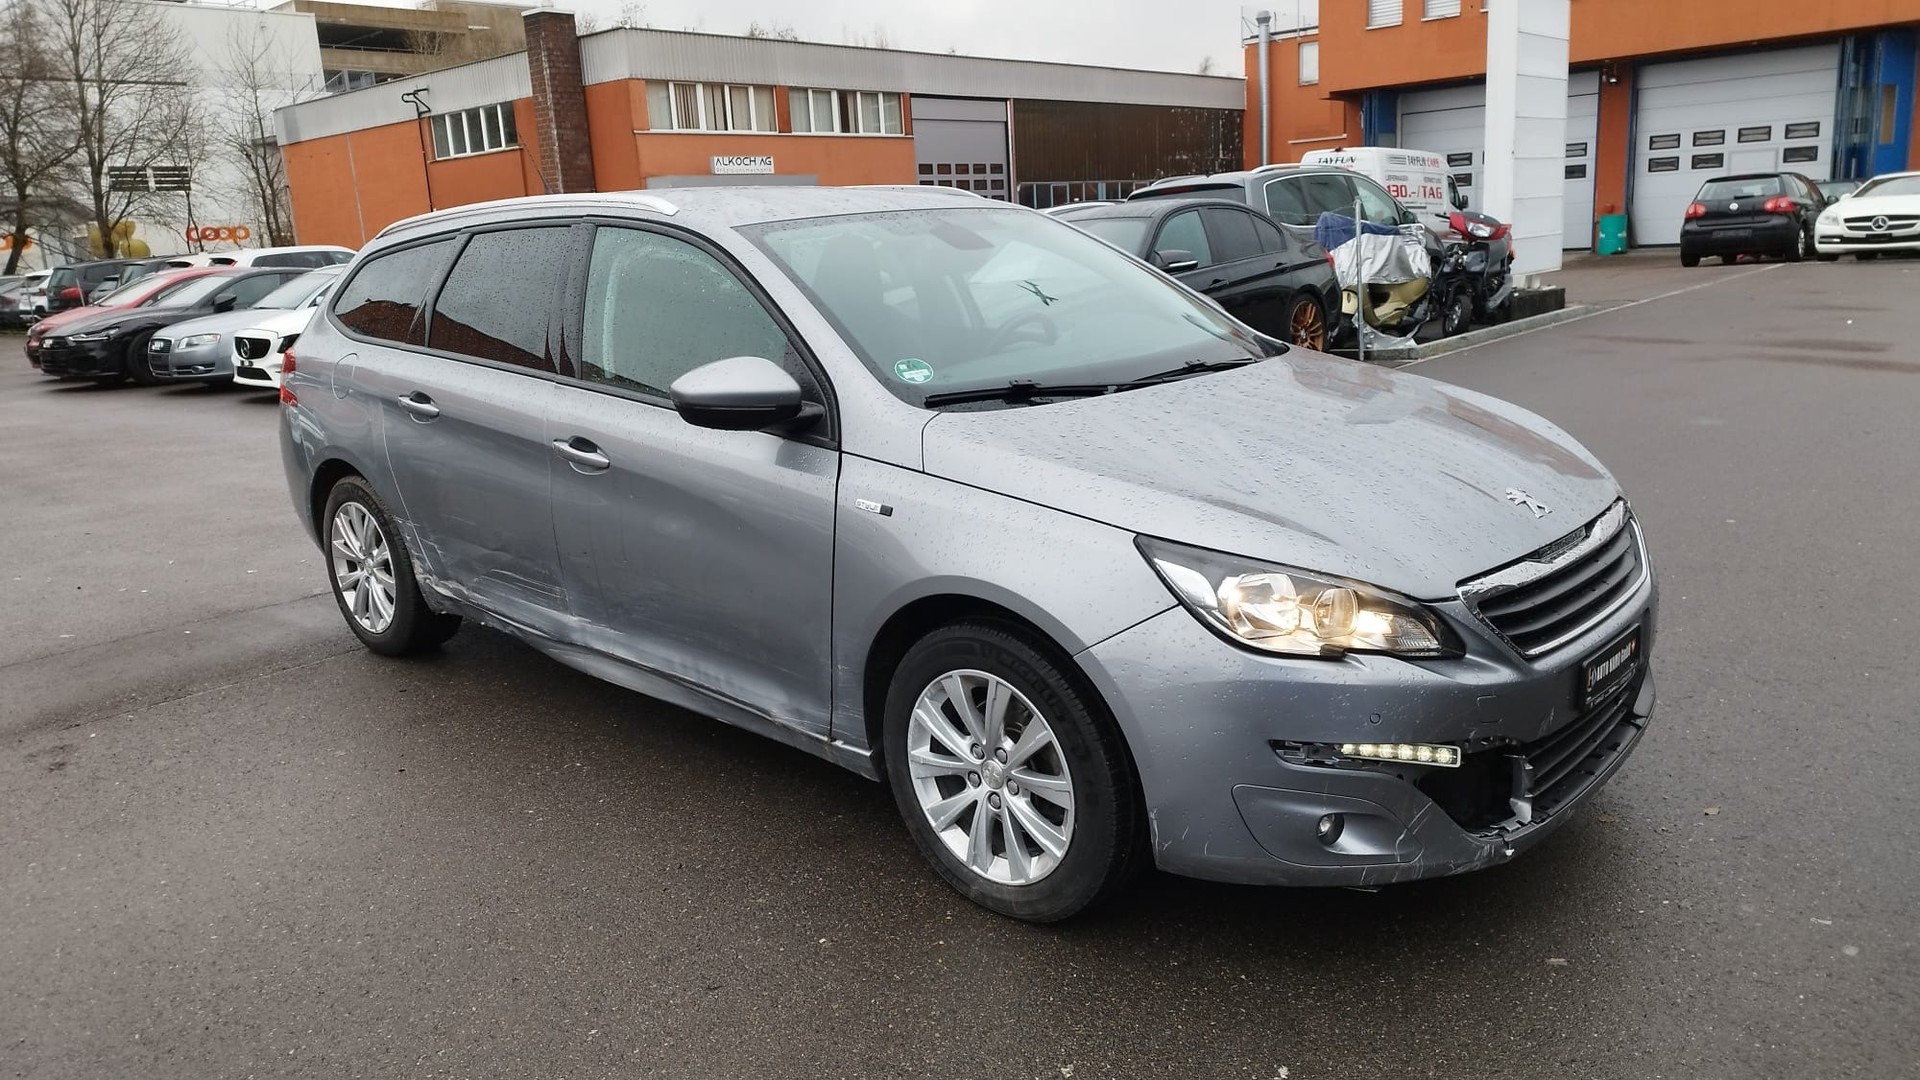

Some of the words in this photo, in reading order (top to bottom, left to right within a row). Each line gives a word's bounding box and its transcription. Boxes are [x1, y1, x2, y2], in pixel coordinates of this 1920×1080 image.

[715, 156, 757, 166] ALKOCH
[759, 156, 772, 166] AG
[1318, 156, 1356, 165] TAYFUN
[1407, 155, 1426, 167] TAYFUN
[186, 227, 250, 245] coop
